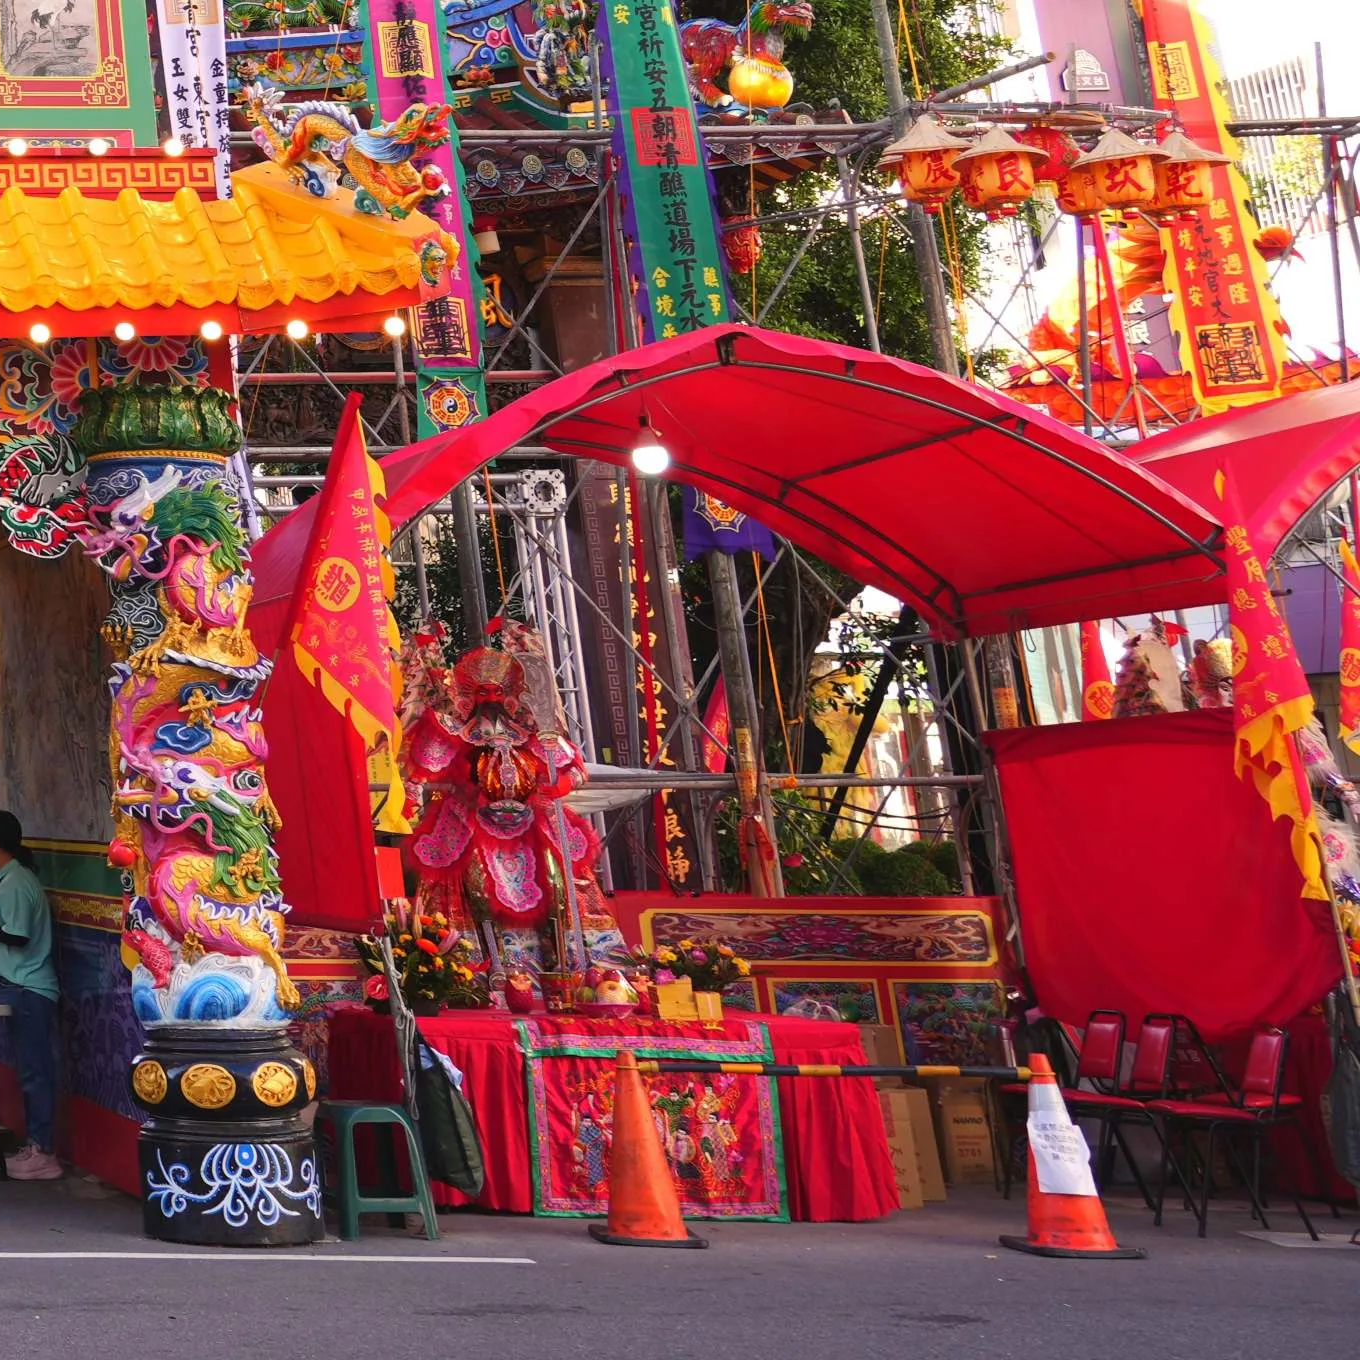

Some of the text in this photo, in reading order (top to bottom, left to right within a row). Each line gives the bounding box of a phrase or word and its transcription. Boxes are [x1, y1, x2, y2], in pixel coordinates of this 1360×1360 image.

[996, 158, 1031, 191] 艮
[1105, 159, 1146, 193] 坎
[1232, 588, 1289, 659] 總壇
